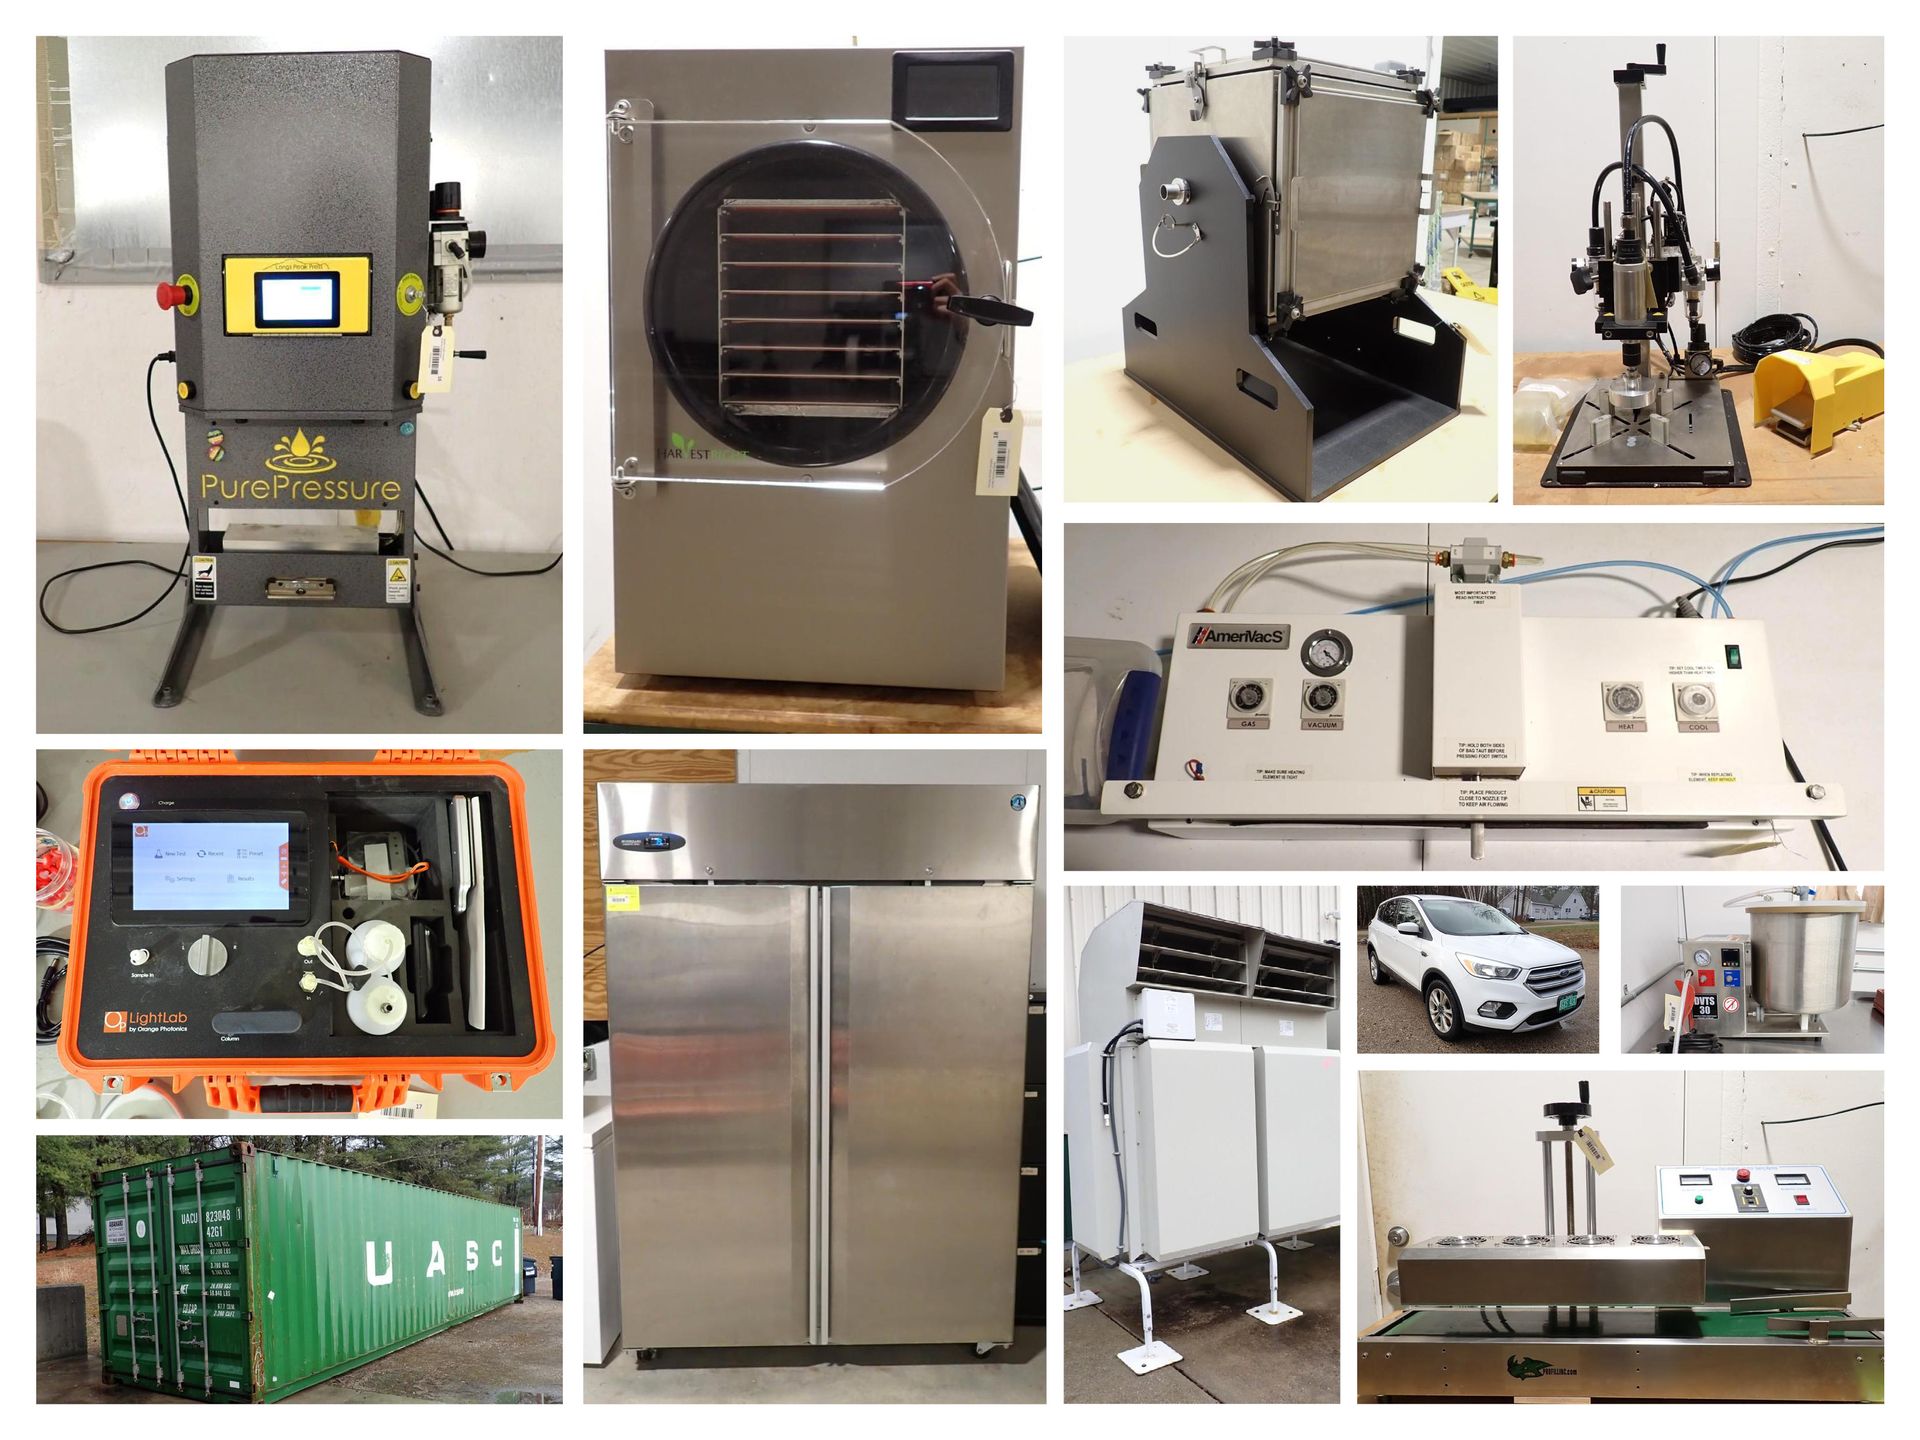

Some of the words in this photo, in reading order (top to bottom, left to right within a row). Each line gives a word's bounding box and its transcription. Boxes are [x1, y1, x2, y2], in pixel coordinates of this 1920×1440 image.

[201, 474, 400, 500] PurePressure
[1205, 630, 1282, 643] AmeriVacS
[1694, 996, 1715, 1005] DVTS
[1700, 1006, 1710, 1014] 30
[130, 1012, 188, 1026] LightLab
[181, 1213, 198, 1224] UACU
[206, 1209, 230, 1222] 823048
[207, 1226, 222, 1237] 42G1
